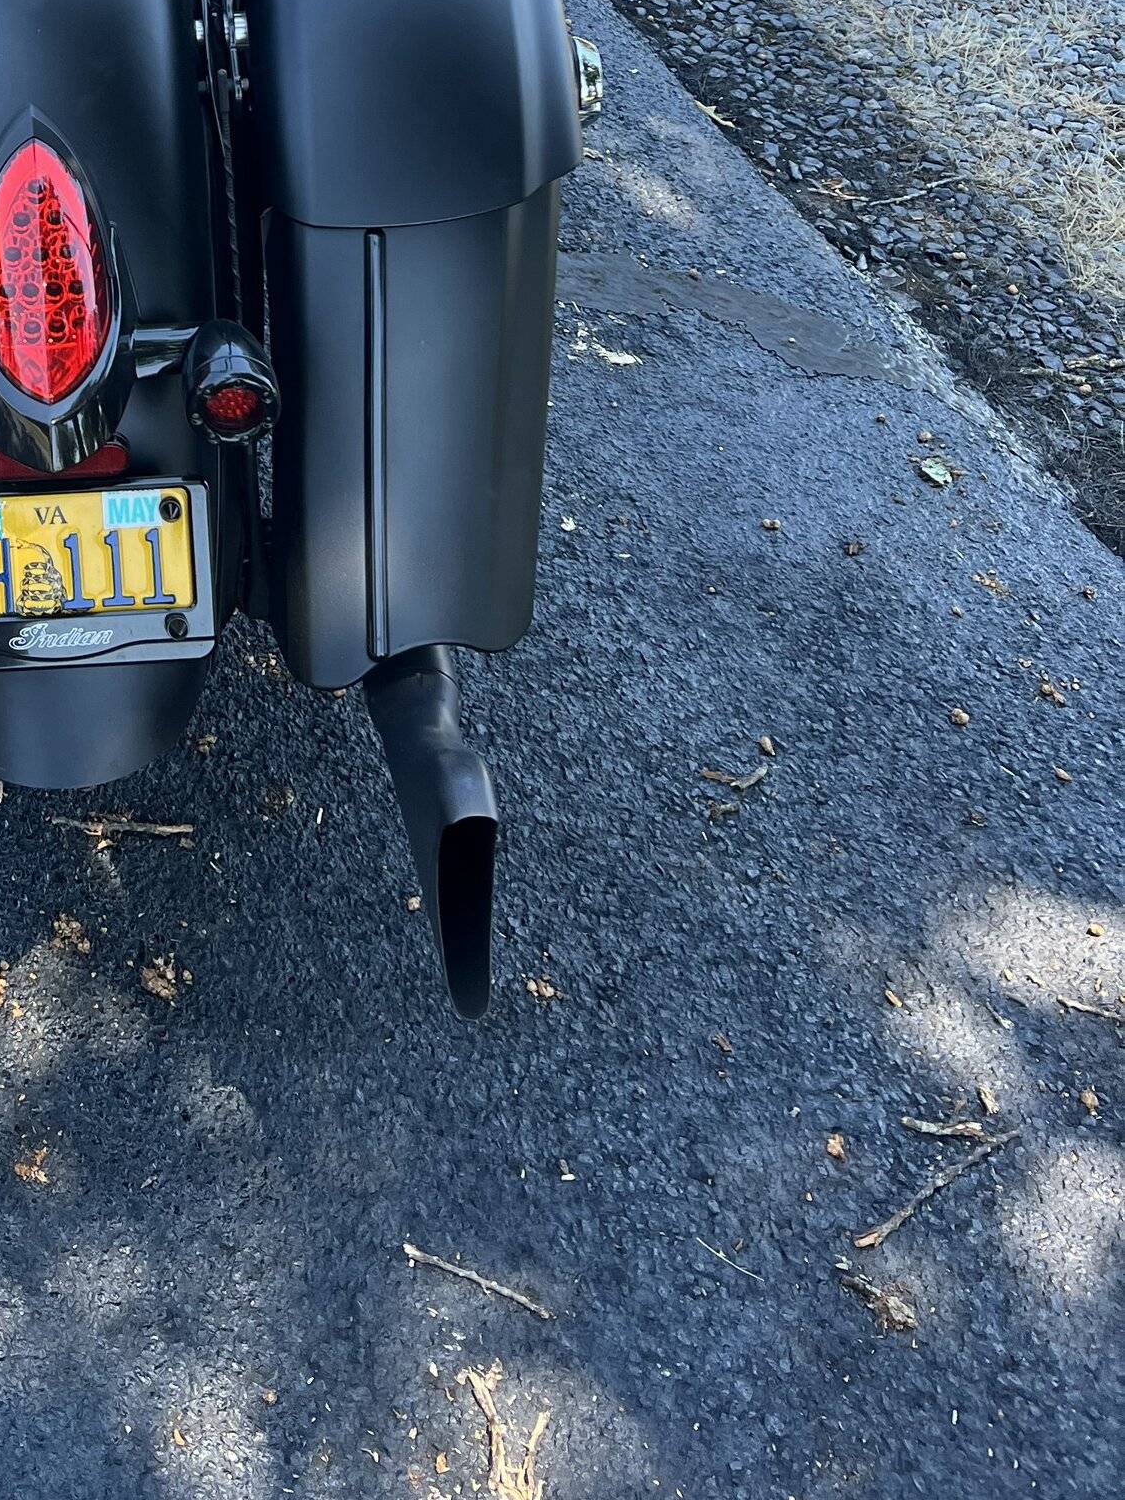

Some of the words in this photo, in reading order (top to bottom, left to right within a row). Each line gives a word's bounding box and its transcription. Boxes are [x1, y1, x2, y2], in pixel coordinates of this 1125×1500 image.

[34, 506, 68, 525] VA
[108, 496, 159, 524] MAY
[62, 528, 177, 610] 111
[8, 622, 114, 650] Indian
